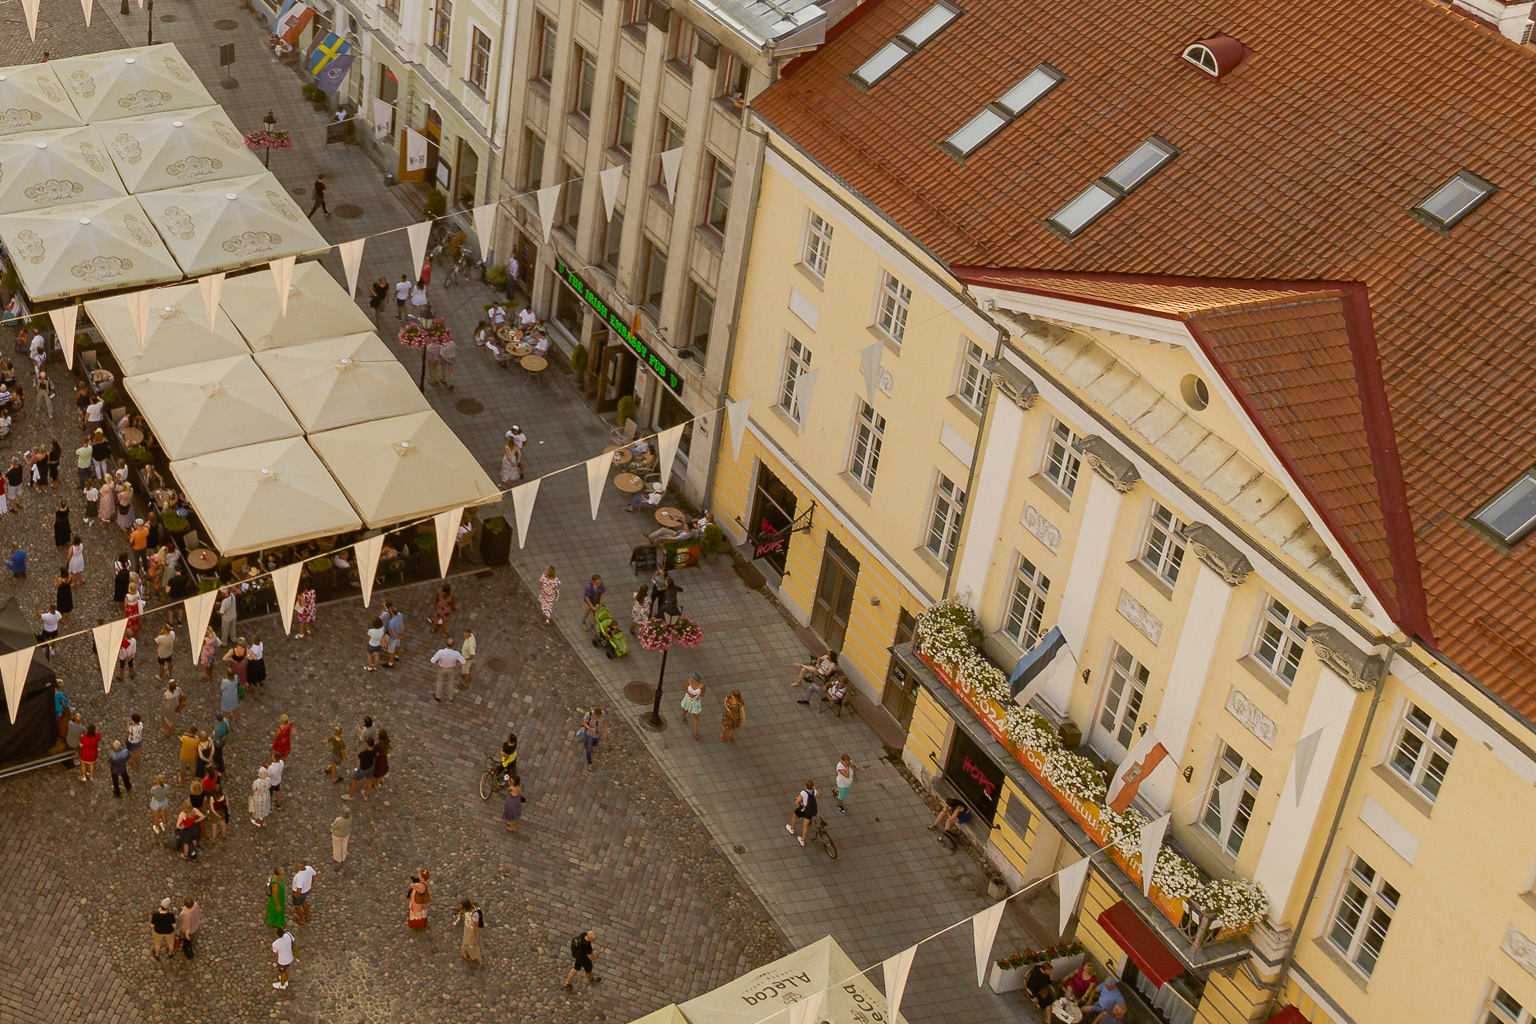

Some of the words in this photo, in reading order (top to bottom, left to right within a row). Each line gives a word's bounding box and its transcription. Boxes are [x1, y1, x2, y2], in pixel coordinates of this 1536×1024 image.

[568, 271, 584, 294] THE
[585, 289, 608, 319] IRISH
[609, 314, 647, 358] EMBASSY
[649, 354, 666, 377] PUB
[756, 538, 784, 557] HOPS
[962, 755, 996, 795] HOPS
